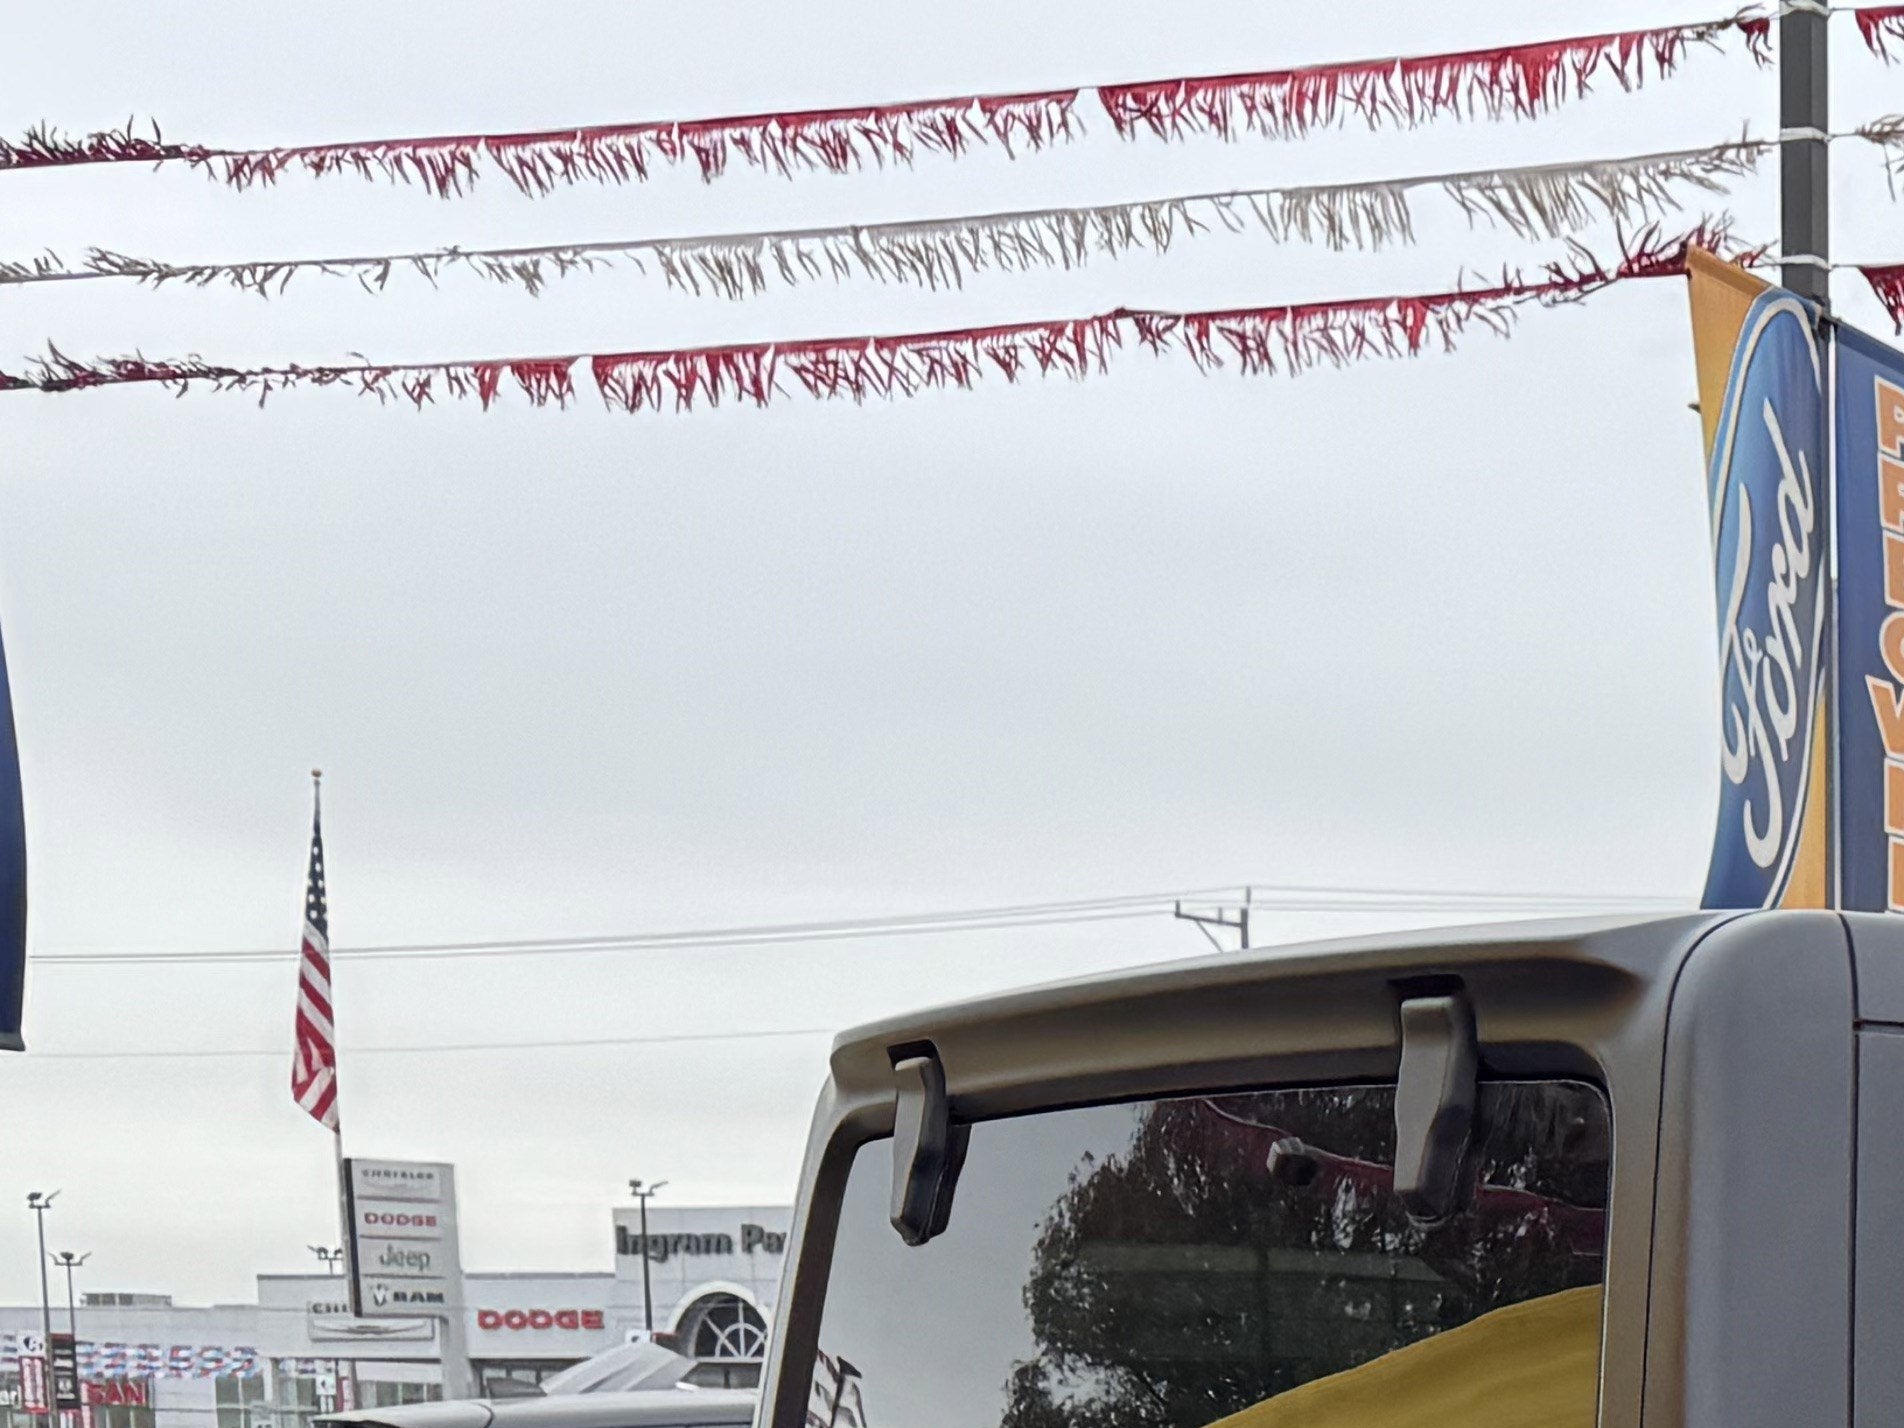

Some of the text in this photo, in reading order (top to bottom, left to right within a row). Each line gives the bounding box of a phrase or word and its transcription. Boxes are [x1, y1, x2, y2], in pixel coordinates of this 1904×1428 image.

[1720, 397, 1818, 868] Ford
[363, 1212, 437, 1228] DODGE
[616, 1225, 734, 1263] Ingram
[379, 1244, 431, 1271] Jeep
[392, 1291, 445, 1304] RAM
[477, 1308, 606, 1330] DODGE
